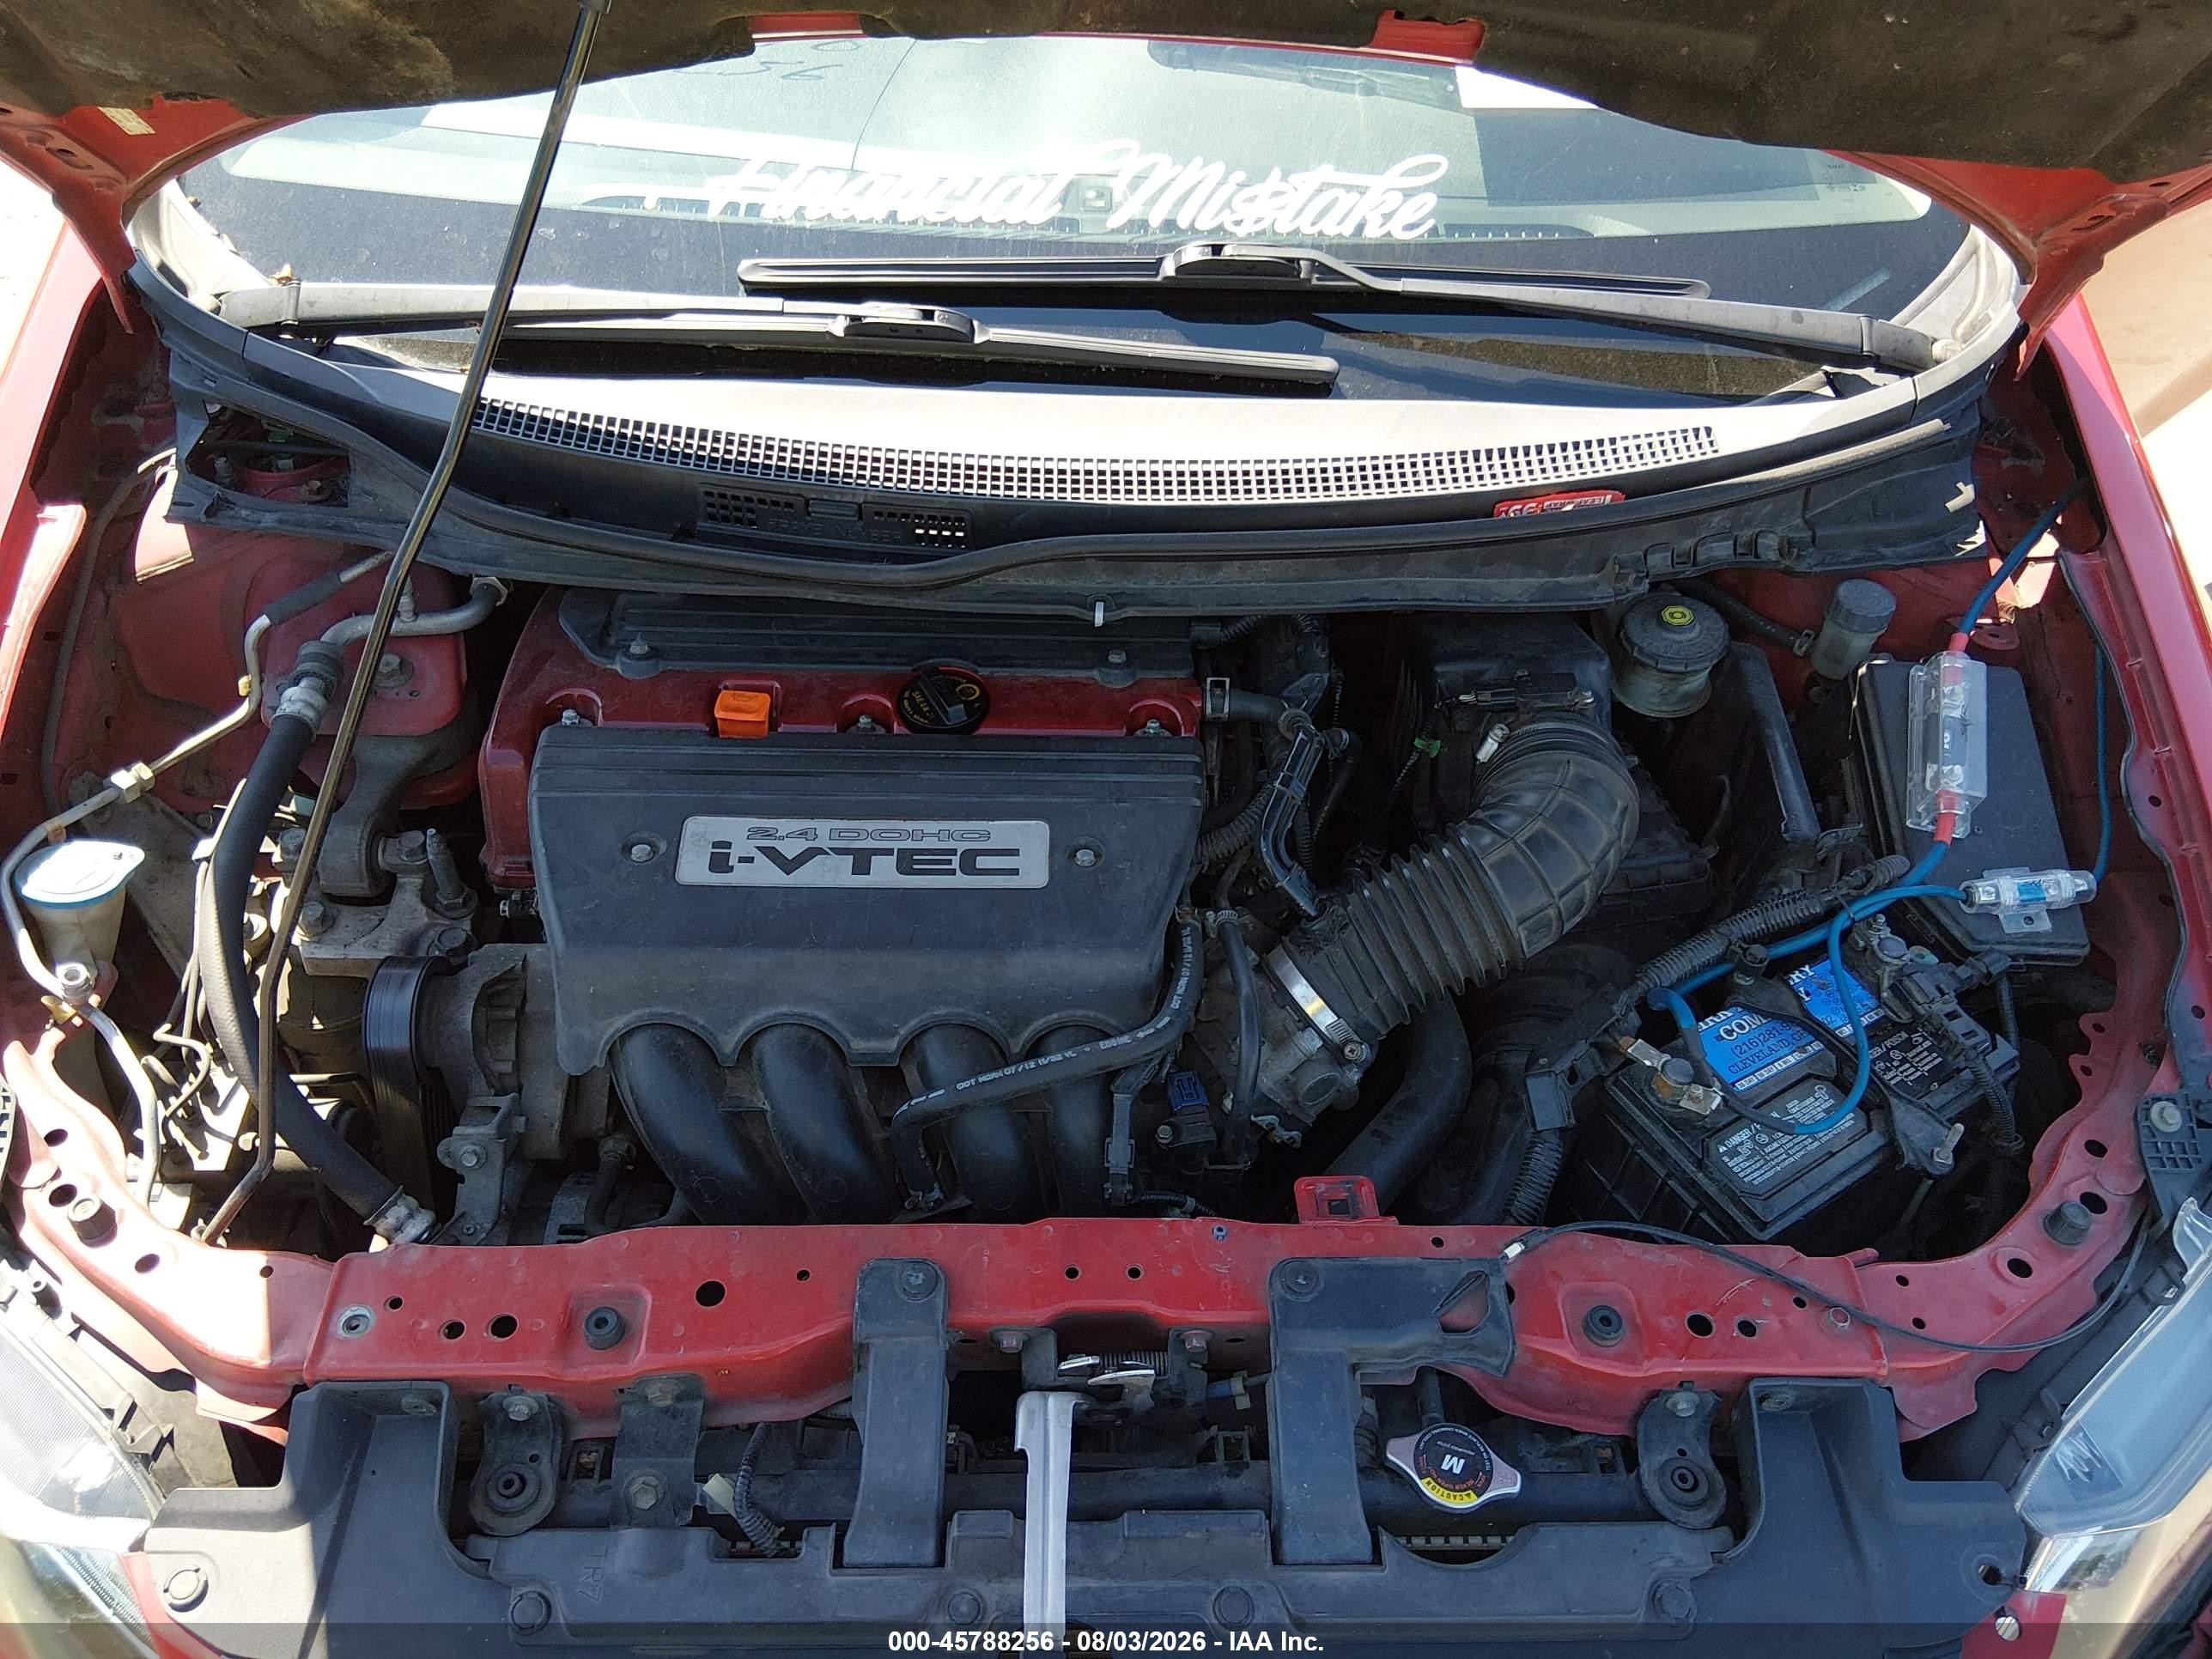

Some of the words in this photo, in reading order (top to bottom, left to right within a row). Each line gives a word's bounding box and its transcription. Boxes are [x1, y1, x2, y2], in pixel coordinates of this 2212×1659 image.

[747, 827, 818, 842] 2.4
[829, 828, 991, 842] DOHC
[708, 840, 1020, 877] i-VTEC
[1441, 1454, 1465, 1474] M
[1425, 1480, 1464, 1501] CAUTION
